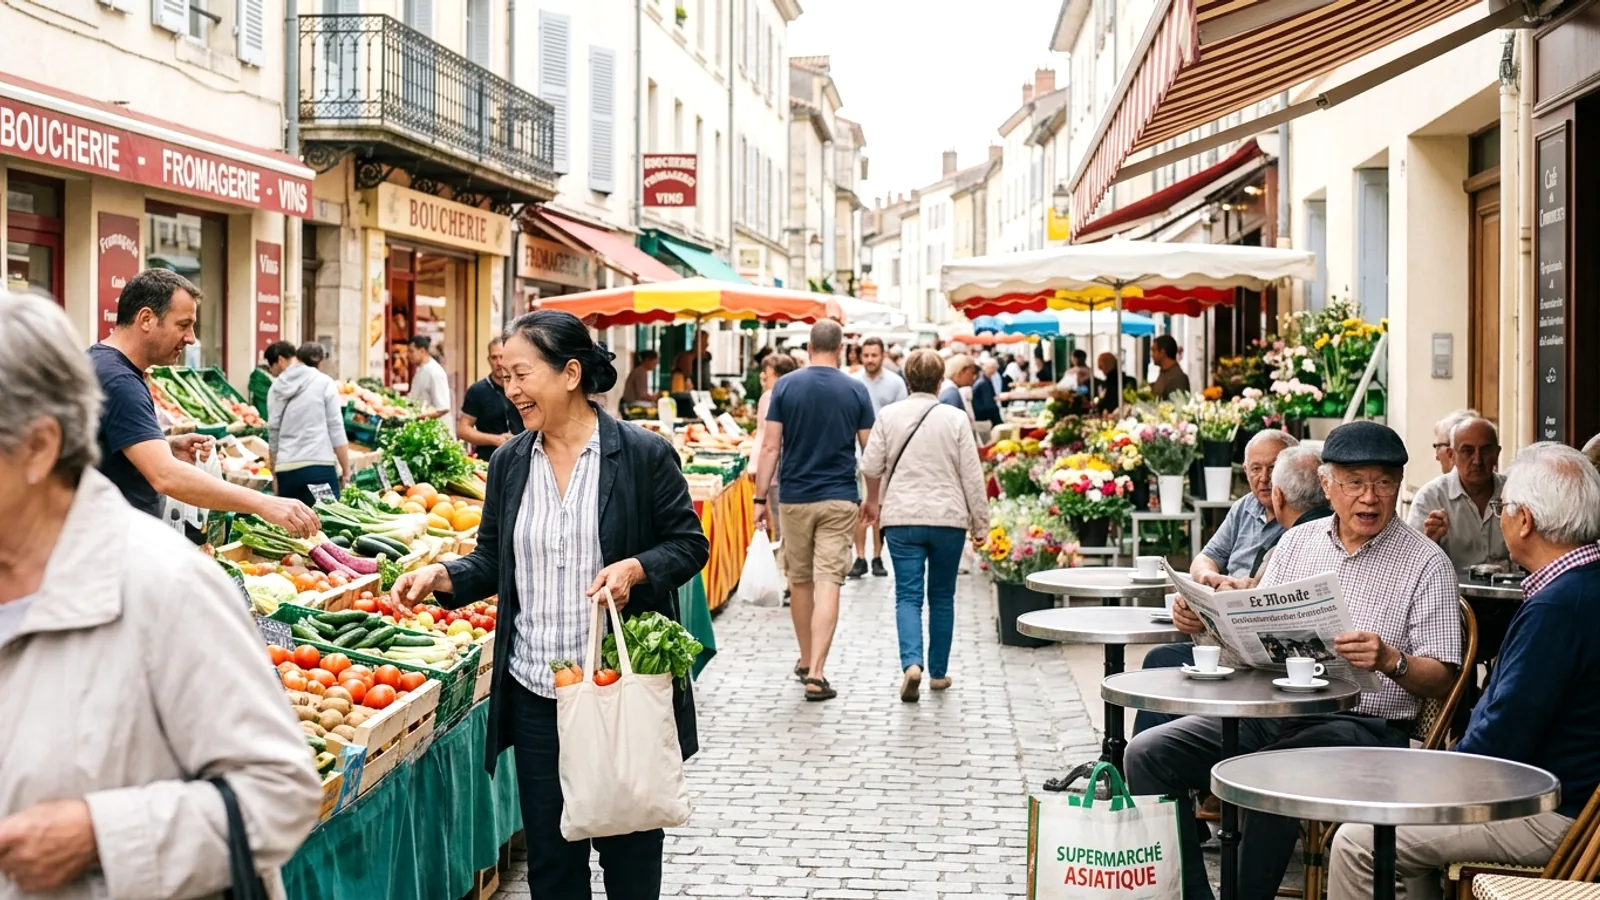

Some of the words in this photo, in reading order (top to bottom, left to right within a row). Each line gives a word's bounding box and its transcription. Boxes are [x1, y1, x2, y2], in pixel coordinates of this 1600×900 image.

[0, 107, 120, 172] BOUCHERIE
[162, 148, 261, 203] FROMAGERIE
[278, 178, 308, 213] VINS
[409, 198, 487, 243] BOUCHERIE
[1264, 588, 1311, 607] Monde
[1056, 841, 1163, 867] SUPERMARCHÉ
[1064, 866, 1157, 890] ASIATIQUE
